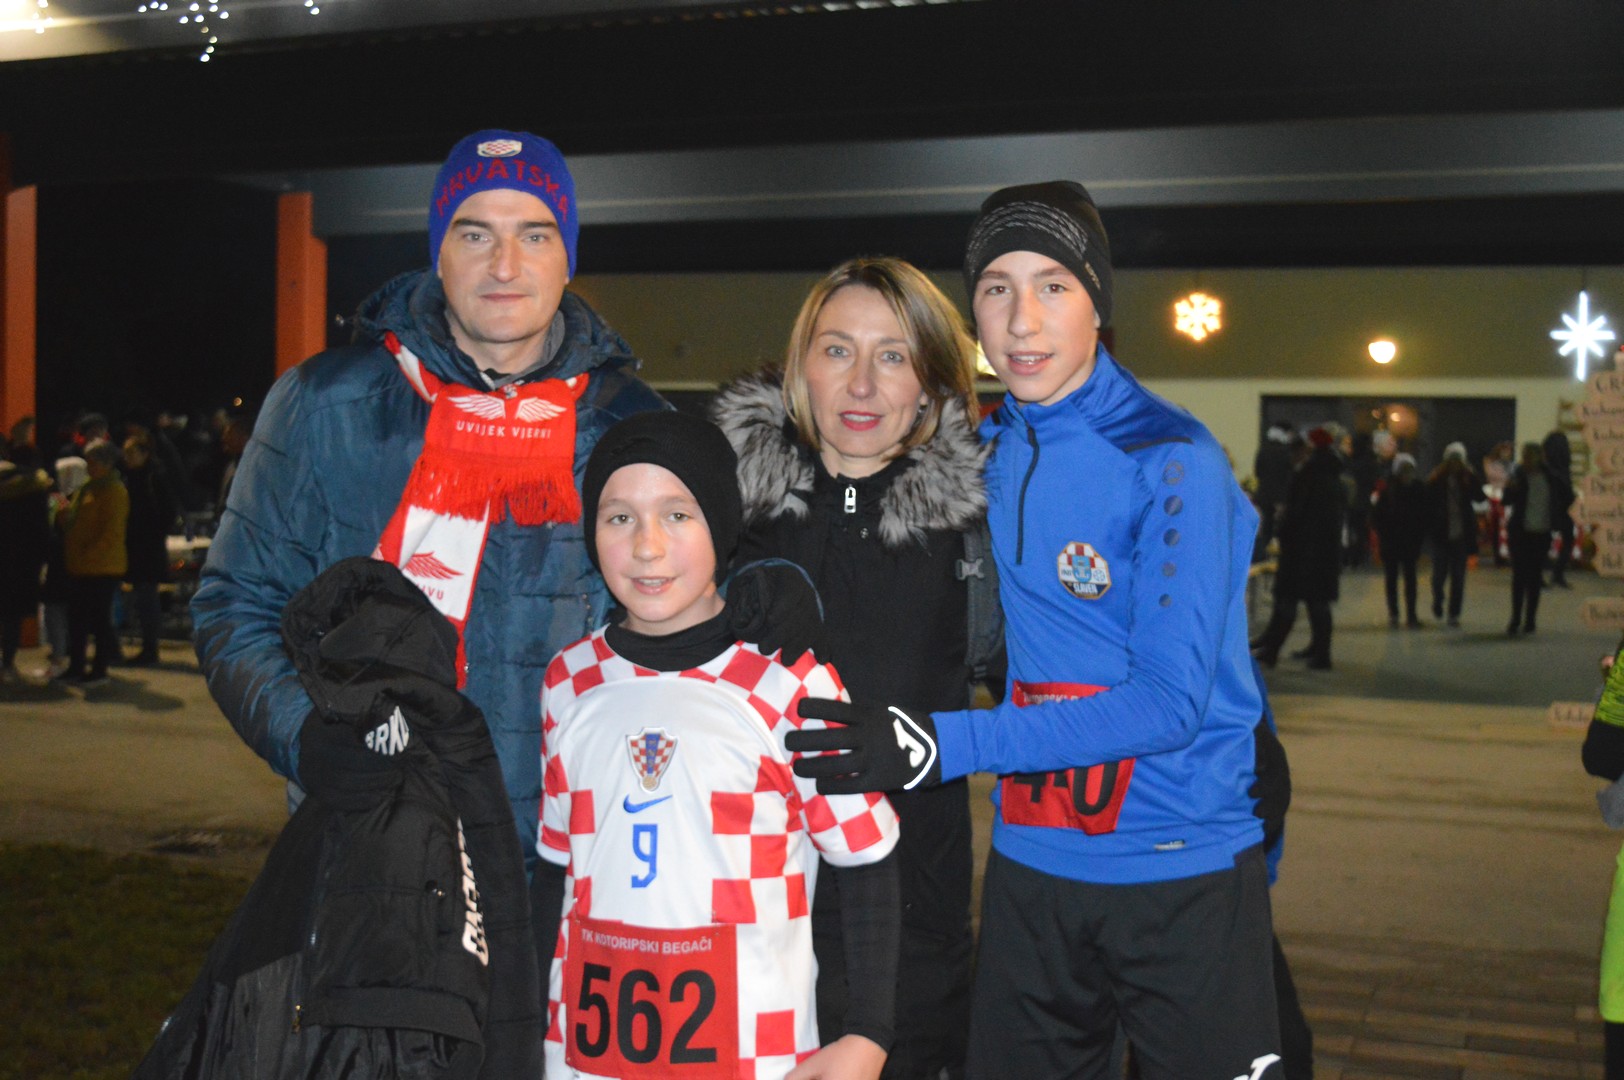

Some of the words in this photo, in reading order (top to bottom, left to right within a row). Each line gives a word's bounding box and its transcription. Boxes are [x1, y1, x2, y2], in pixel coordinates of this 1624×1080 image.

[436, 158, 568, 223] HRVATSKA
[456, 420, 506, 438] UVIJEK
[511, 426, 552, 440] VJERNI
[631, 823, 658, 888] 9
[582, 928, 594, 943] TK
[595, 931, 660, 954] KOTORIPSKI
[661, 936, 713, 955] BEGAČI
[575, 961, 717, 1064] 562
